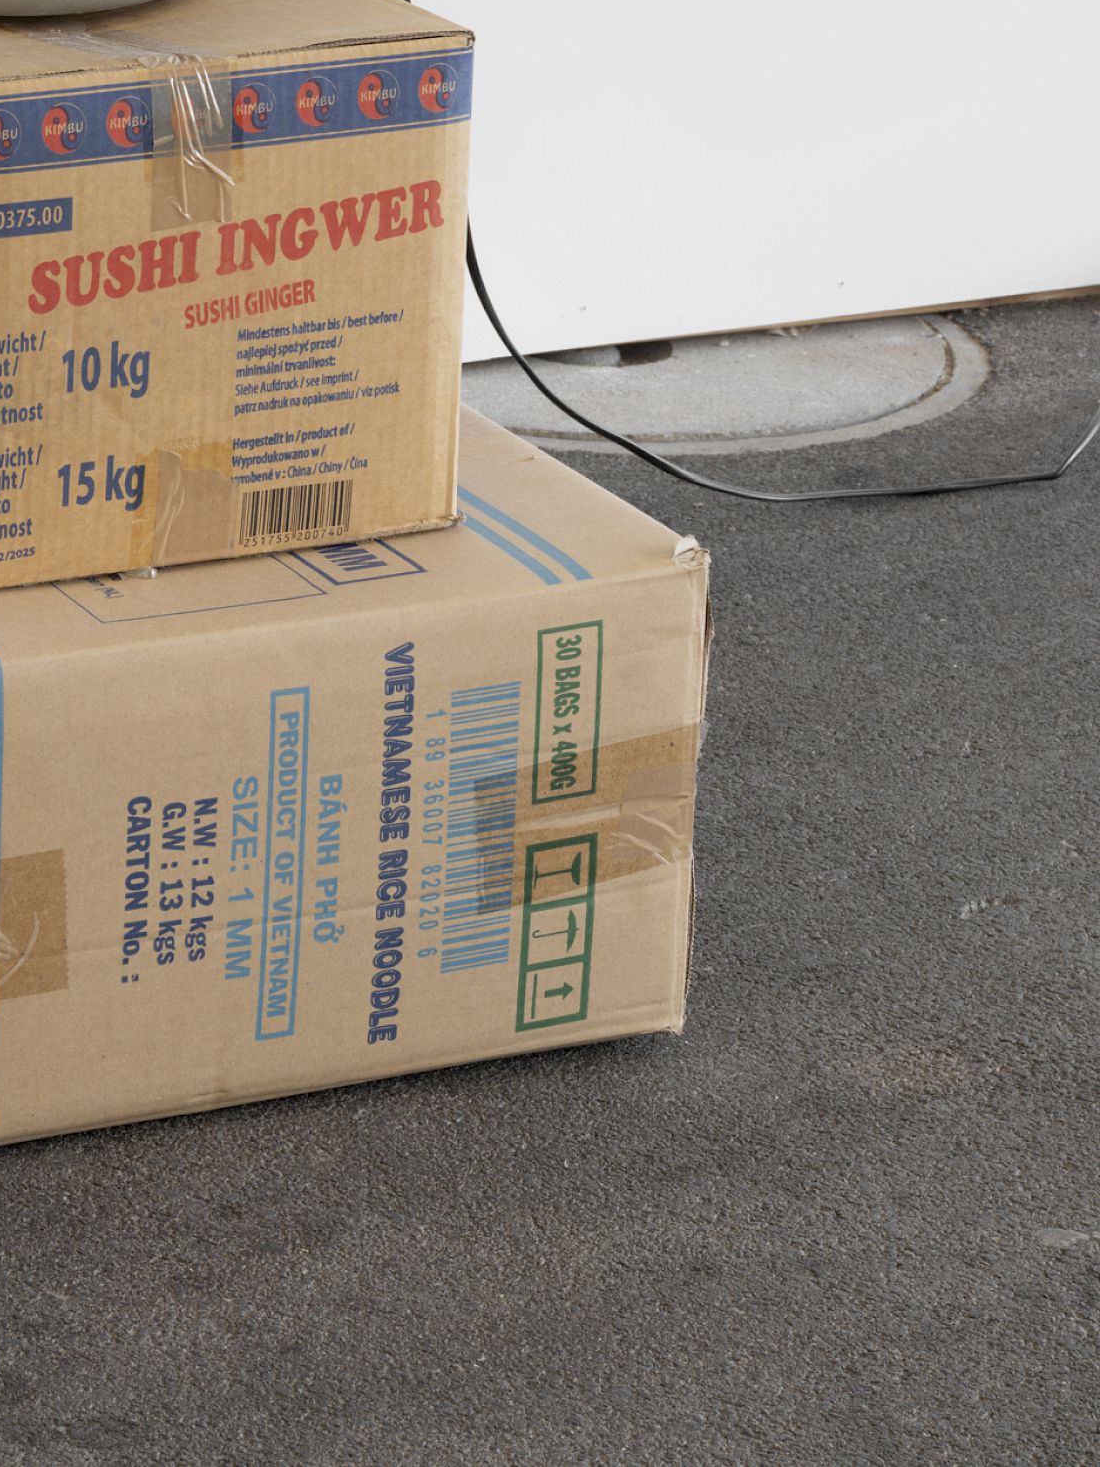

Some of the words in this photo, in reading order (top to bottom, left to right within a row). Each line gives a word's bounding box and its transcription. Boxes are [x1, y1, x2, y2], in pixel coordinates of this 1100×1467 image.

[44, 121, 84, 135] KIMBU
[109, 114, 148, 128] KIMBU
[236, 101, 274, 115] KIMBU
[298, 94, 336, 109] KIMBU
[360, 87, 397, 101] KIMBU
[422, 80, 457, 95] KIMBU
[28, 231, 202, 315] SUSHI
[215, 179, 445, 275] INGWER
[184, 295, 241, 329] SUSHI
[245, 280, 316, 318] GINGER
[237, 325, 290, 342] Mindestens
[292, 320, 326, 335] haltbar
[327, 317, 340, 330] bis
[348, 314, 367, 329] best
[369, 310, 398, 325] before
[310, 336, 337, 352] przed
[62, 346, 101, 393] 10
[110, 341, 150, 398] kg
[235, 382, 259, 397] Siehe
[260, 377, 298, 394] Aufdruck
[306, 377, 320, 387] see
[321, 369, 353, 386] imprint
[234, 401, 257, 417] patrz
[258, 397, 289, 412] nadruk
[290, 396, 300, 408] na
[232, 448, 309, 470] Wyprodukowano
[233, 433, 284, 451] Hergestellt
[301, 426, 338, 443] product
[57, 461, 96, 507] 15
[105, 455, 146, 511] kg
[288, 465, 312, 479] China
[318, 461, 343, 474] Chiny
[244, 534, 291, 548] 251755
[297, 527, 343, 541] 200740
[556, 634, 582, 661] 30
[425, 708, 448, 719] 1
[552, 666, 581, 719] BAGS
[379, 641, 415, 844] VIETNAMESE
[424, 737, 446, 763] 89
[549, 740, 578, 792] 400G
[275, 710, 300, 840] PRODUCT
[161, 802, 187, 851] G.W
[192, 797, 218, 847] N.W
[230, 775, 259, 872] SIZE:
[316, 773, 348, 867] BÁNH
[421, 779, 445, 846] 36007
[124, 796, 153, 911] CARTON
[273, 851, 295, 884] OF
[159, 879, 184, 912] 13
[191, 875, 214, 908] 12
[228, 887, 254, 902] 1
[376, 848, 409, 921] RICE
[418, 864, 442, 931] 82020
[153, 919, 182, 966] kgs
[184, 915, 213, 962] kgs
[224, 918, 253, 980] MM
[266, 895, 293, 1018] VIETNAM
[416, 947, 438, 959] 6
[367, 926, 404, 1045] NOODLE
